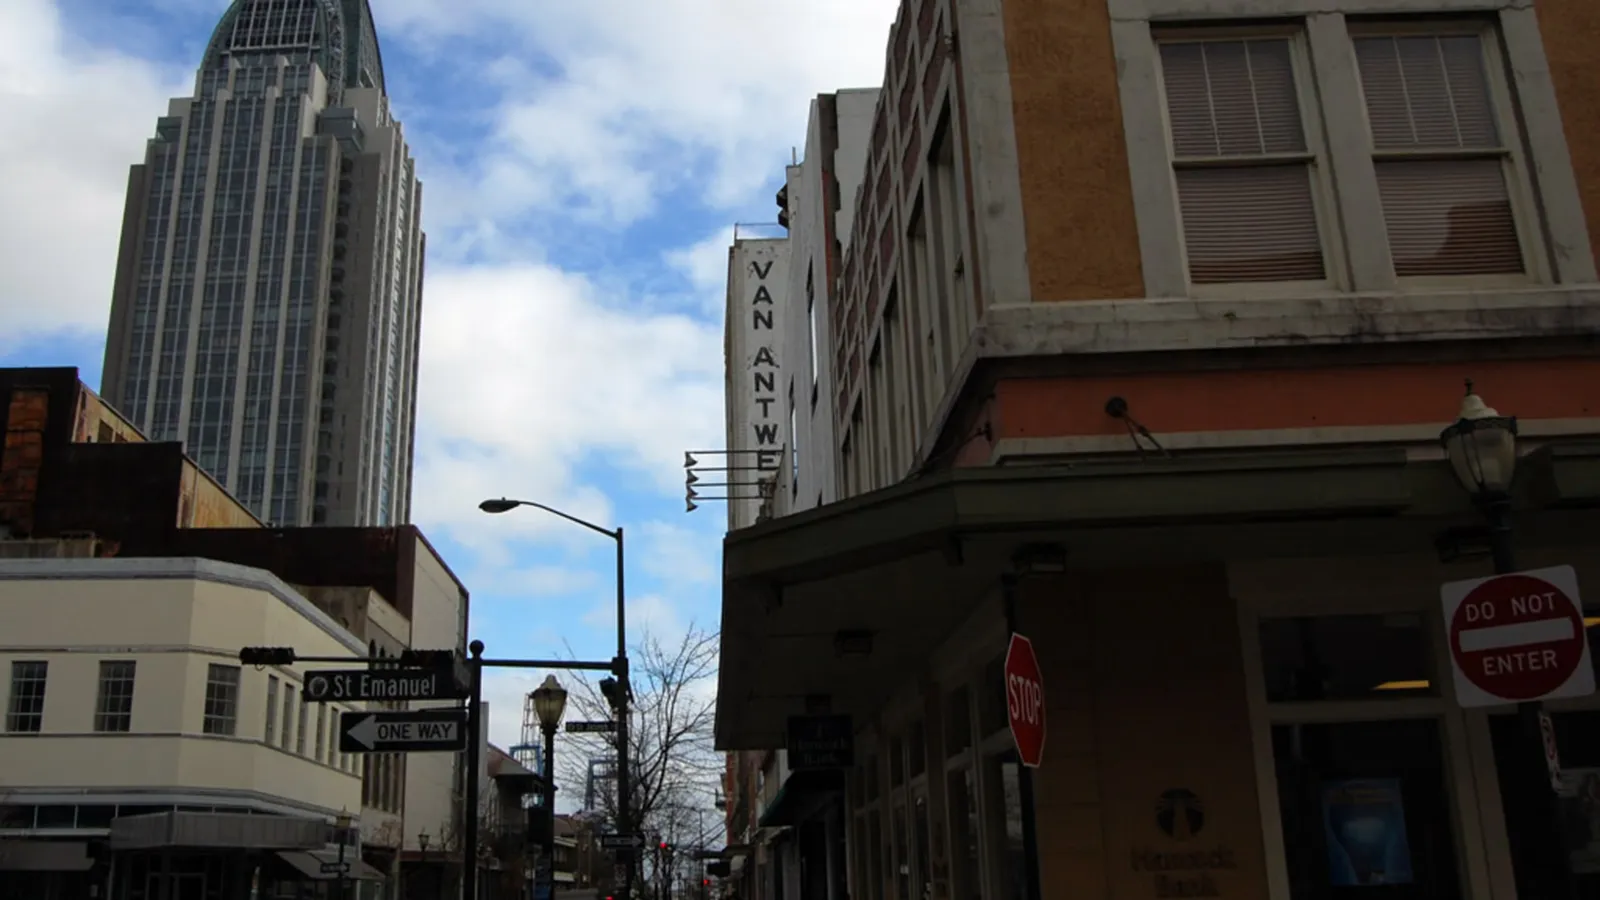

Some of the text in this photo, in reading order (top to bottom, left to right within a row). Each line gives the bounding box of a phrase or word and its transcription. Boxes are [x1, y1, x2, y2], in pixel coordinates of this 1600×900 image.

[752, 262, 778, 518] VAN ANTWE
[1465, 593, 1556, 622] DO NOT
[1483, 650, 1558, 676] ENTER
[333, 673, 437, 698] St Emanuel
[1009, 675, 1042, 725] STOP
[377, 723, 454, 740] ONE WAY
